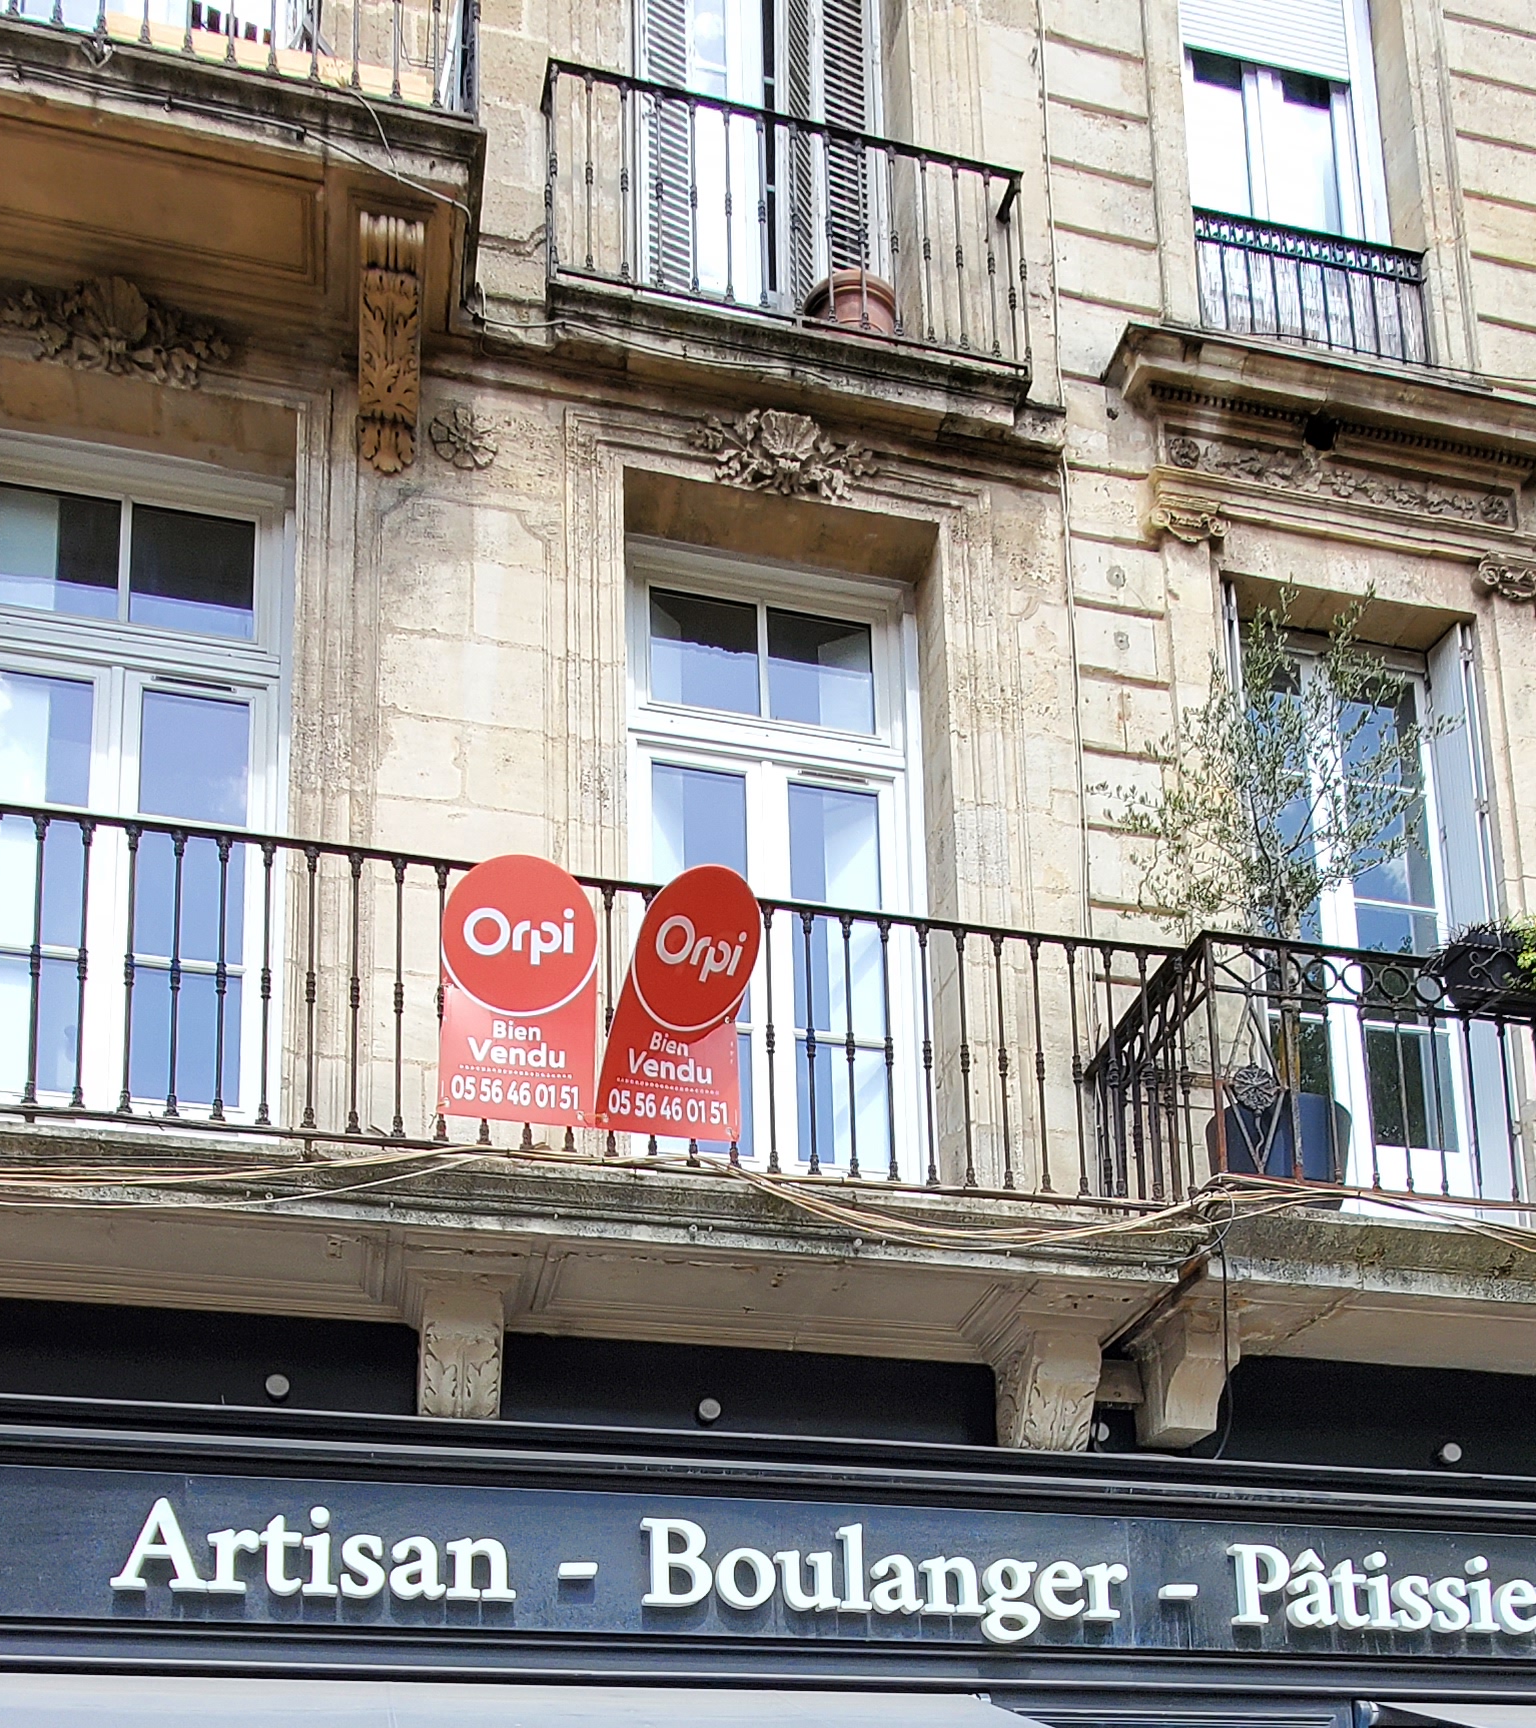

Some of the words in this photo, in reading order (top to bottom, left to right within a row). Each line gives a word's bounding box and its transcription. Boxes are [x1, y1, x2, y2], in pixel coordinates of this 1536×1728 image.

[463, 907, 576, 965] Orpi
[655, 914, 748, 983] Orpi
[492, 1020, 541, 1042] Bien
[649, 1030, 689, 1057] Bien
[467, 1036, 566, 1068] Vendu
[628, 1047, 713, 1085] Vendu
[451, 1075, 476, 1100] 05
[479, 1078, 503, 1103] 56
[506, 1080, 531, 1106] 46
[535, 1083, 556, 1109] 01
[559, 1085, 580, 1111] 51
[608, 1088, 631, 1114] 05
[634, 1090, 657, 1117] 56
[660, 1094, 683, 1120] 46
[686, 1097, 707, 1123] 01
[710, 1100, 729, 1125] 51
[109, 1496, 517, 1602] Artisan
[639, 1516, 1128, 1643] Boulanger
